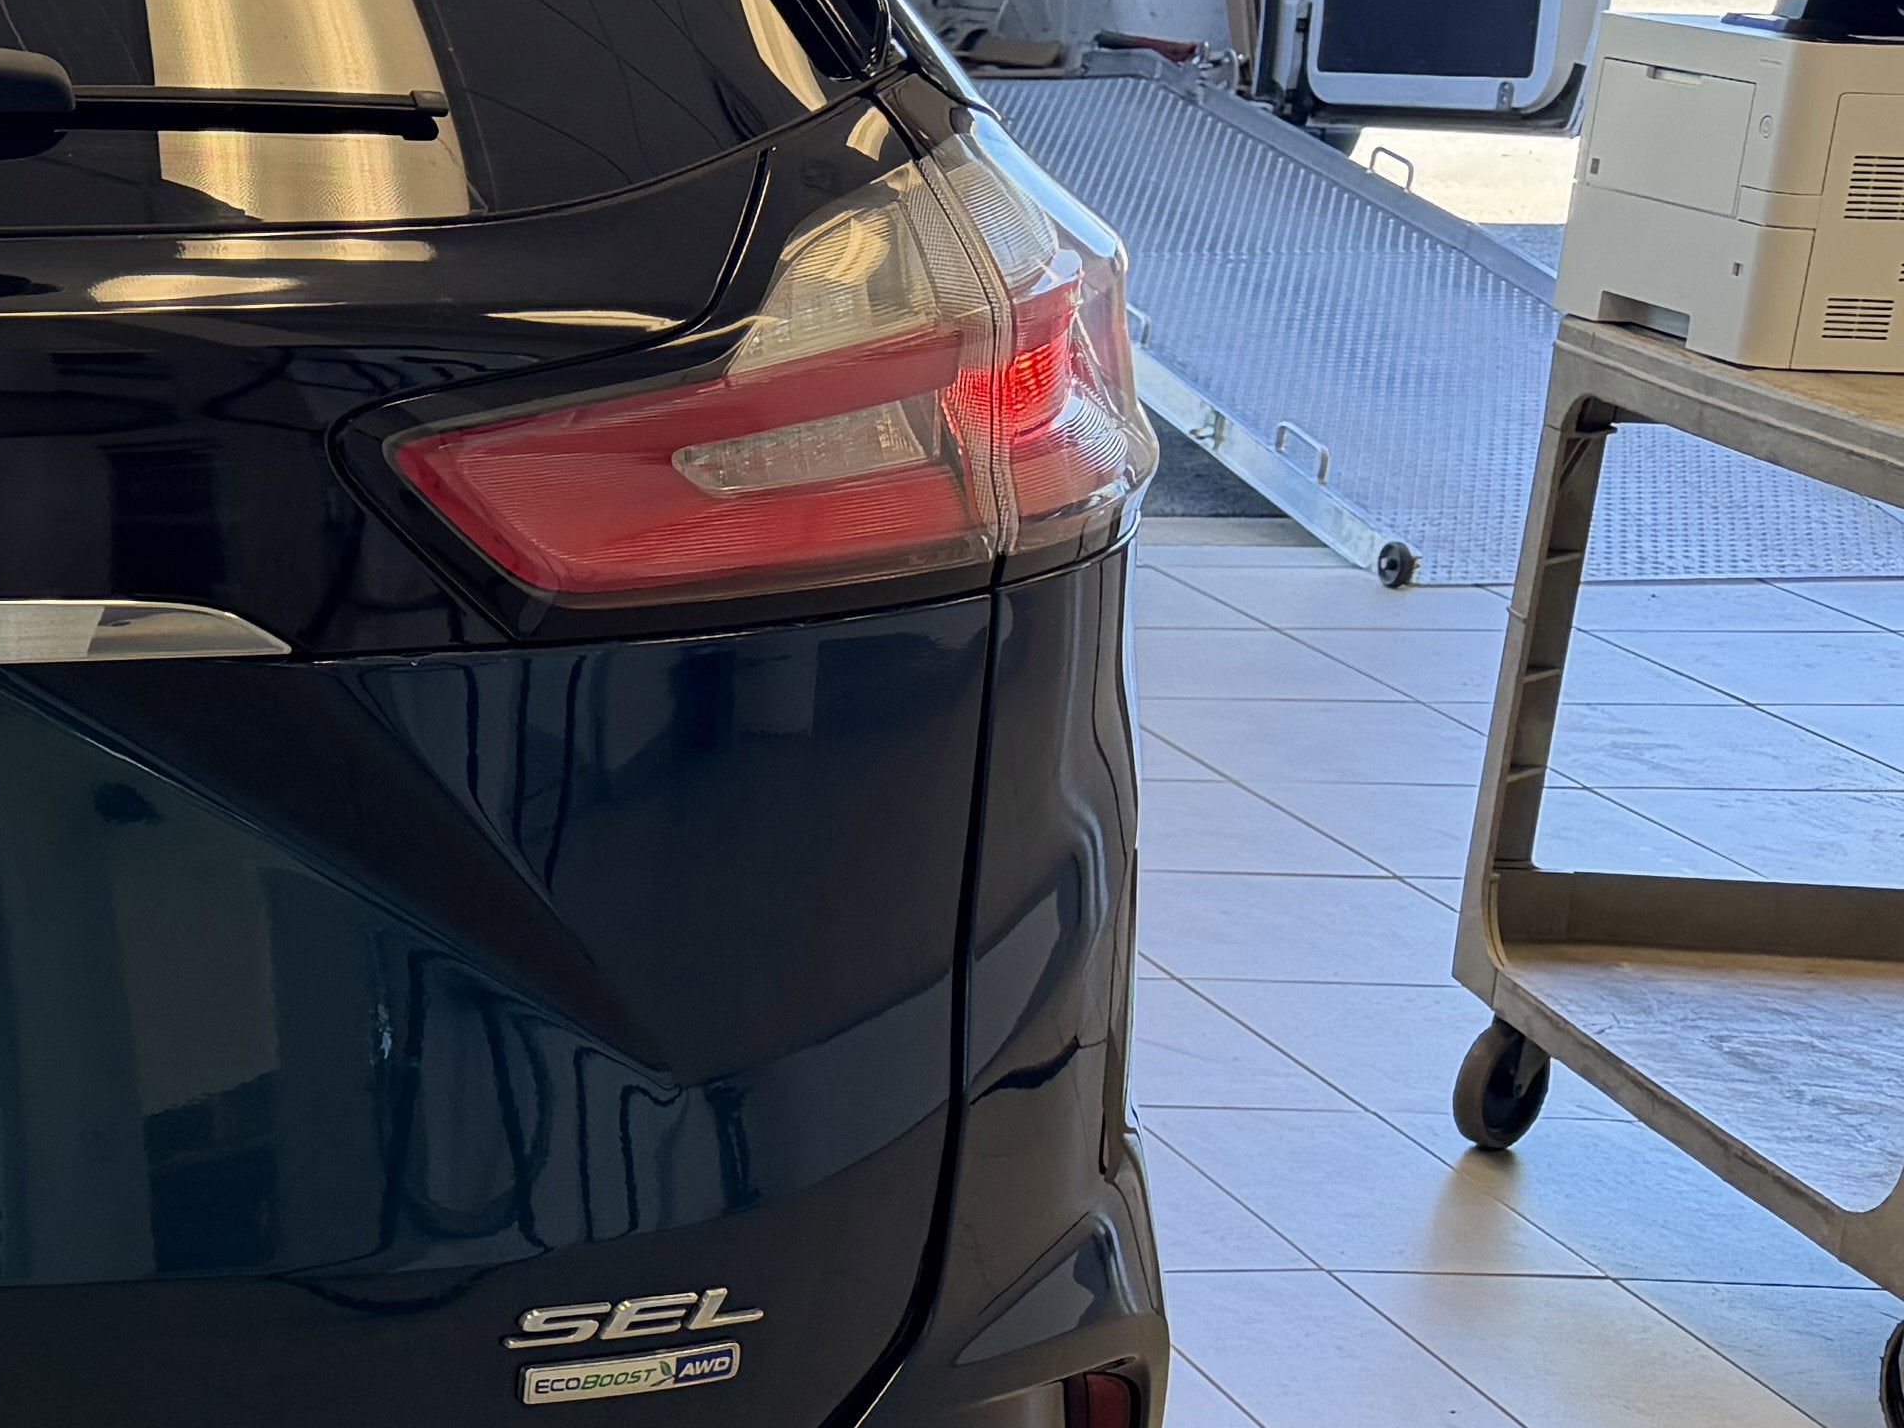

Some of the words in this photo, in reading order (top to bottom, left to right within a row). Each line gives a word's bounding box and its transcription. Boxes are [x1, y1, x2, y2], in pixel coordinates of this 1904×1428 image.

[503, 1287, 765, 1350] SEL
[534, 1367, 657, 1395] ECOBOOST
[677, 1355, 732, 1379] AWD
